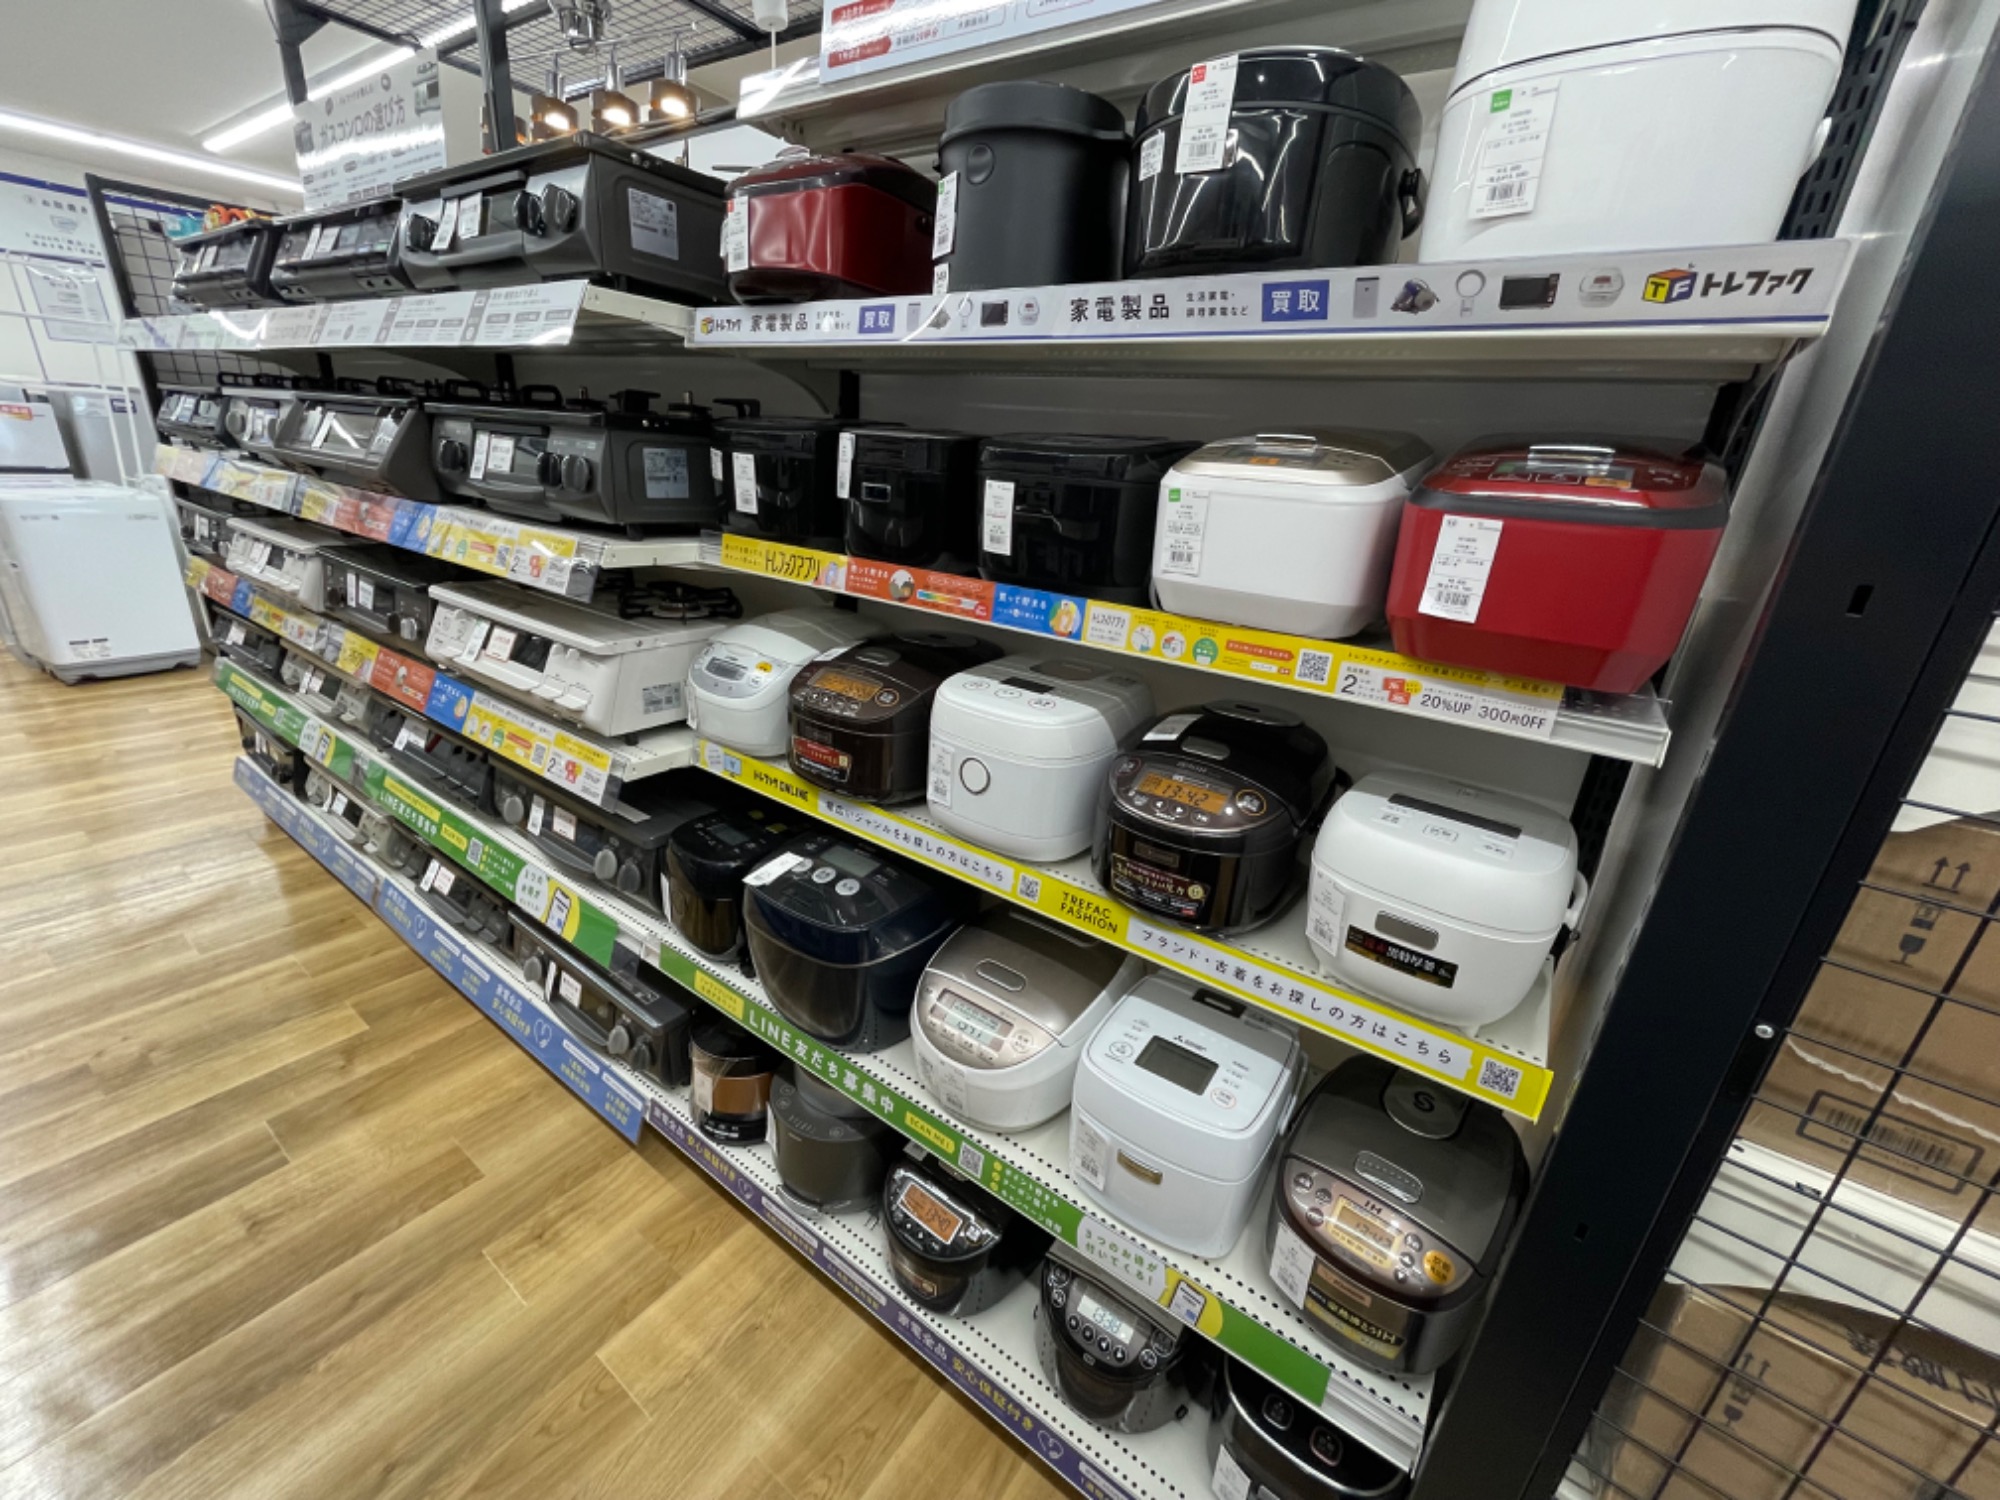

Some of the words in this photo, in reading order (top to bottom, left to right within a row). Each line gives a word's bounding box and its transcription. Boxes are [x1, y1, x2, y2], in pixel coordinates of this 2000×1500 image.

[1700, 267, 1815, 297] トレファク
[1071, 294, 1170, 322] 家電製品
[1271, 288, 1321, 314] 買取
[751, 313, 808, 332] 家電製品
[864, 310, 891, 328] 買取
[1341, 673, 1359, 695] 2
[1420, 693, 1472, 714] 20%UP
[1060, 902, 1118, 935] FASHION
[1062, 891, 1113, 921] TREFAC
[1141, 929, 1454, 1066] ブランド・古着をお探しの方はこちら
[750, 1009, 895, 1114] LINE友だち募集中
[909, 1116, 934, 1139] SCAN
[898, 1310, 948, 1360] 家電全品
[952, 1356, 1034, 1432] 安心保証付き
